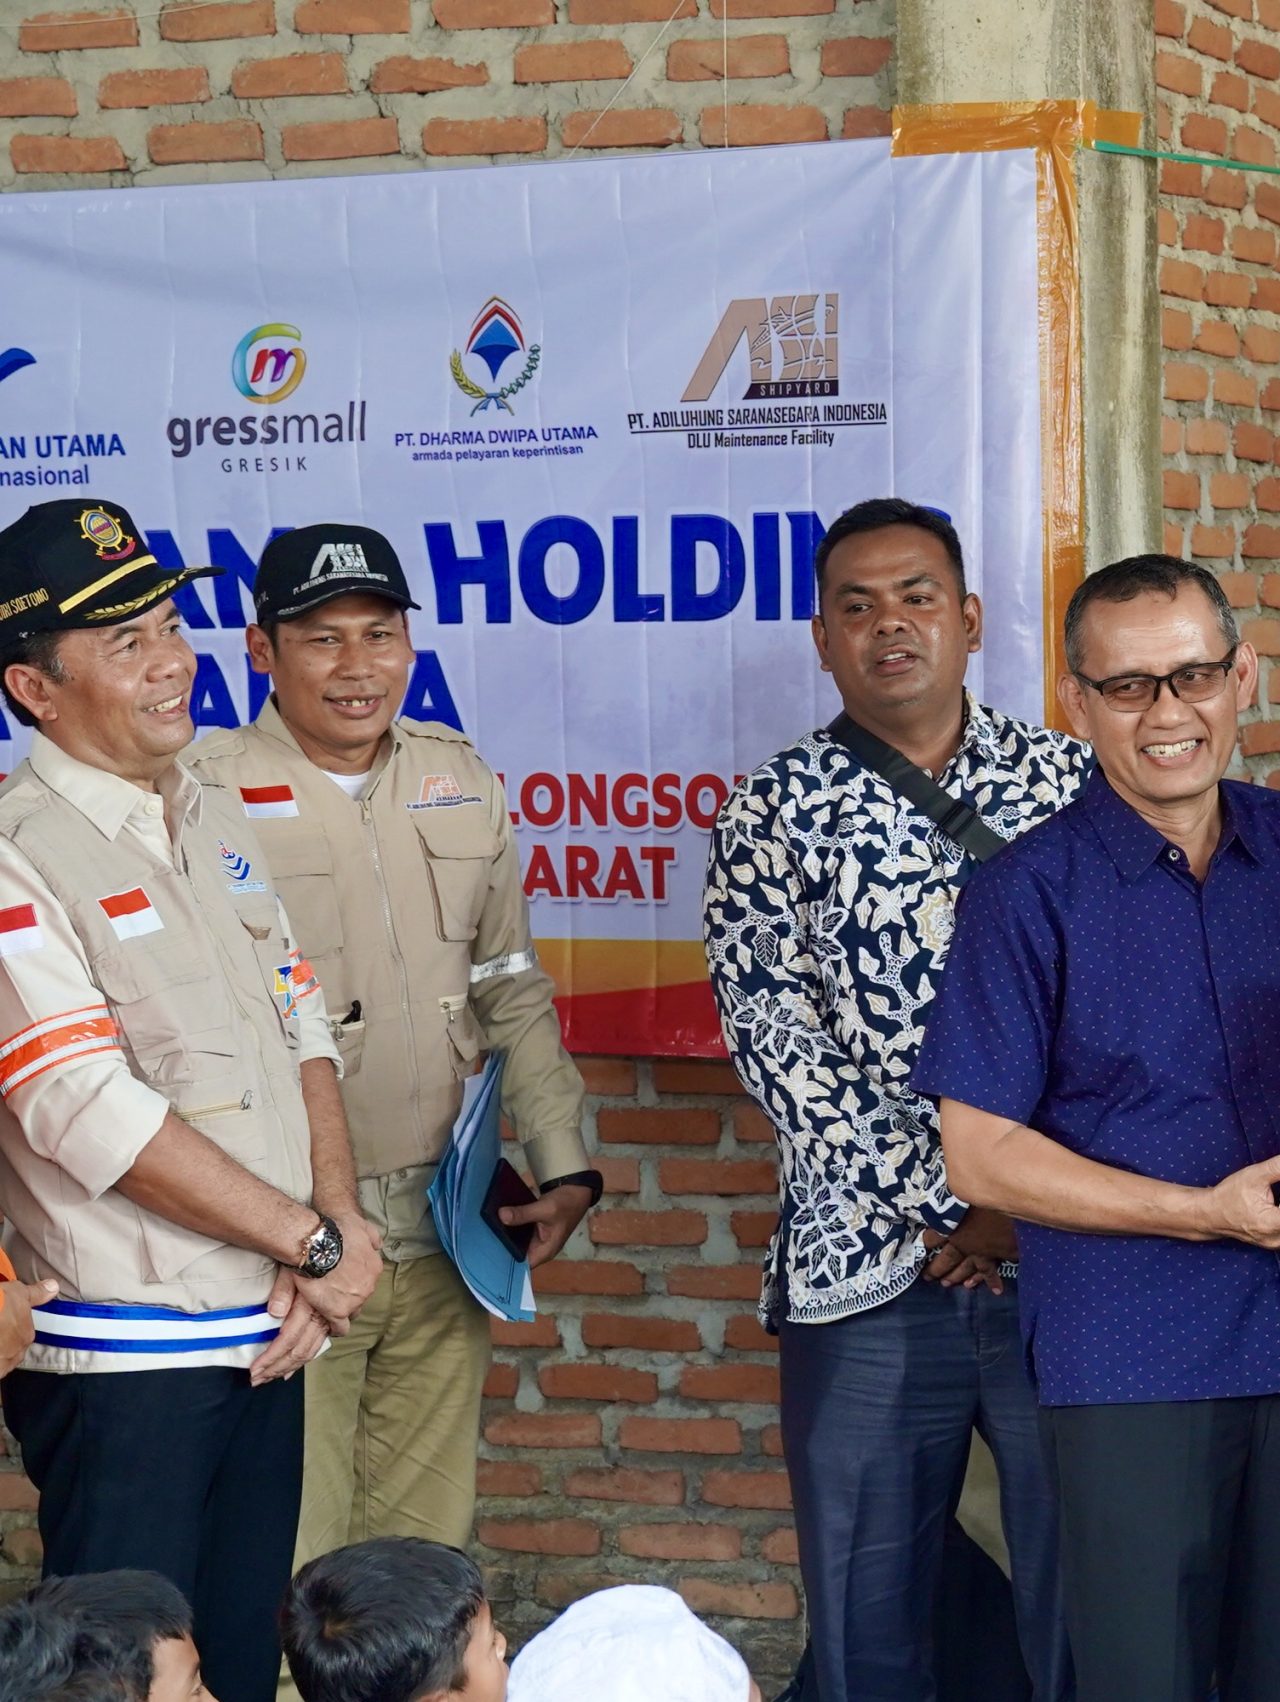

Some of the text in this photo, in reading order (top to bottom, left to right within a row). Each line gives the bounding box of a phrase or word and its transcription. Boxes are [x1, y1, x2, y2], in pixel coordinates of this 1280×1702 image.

[627, 403, 887, 429] PT. ADILUHUNG SARANASEGARA INDONESIA
[167, 400, 366, 458] gressmall
[395, 426, 598, 446] PT. DHARMA DWIPA UTAMA
[687, 429, 835, 448] DLU Maintenance Facility
[35, 433, 127, 458] UTAMA
[412, 445, 583, 462] armada pelayaran keperintisan
[221, 457, 307, 473] GRESIK
[523, 845, 675, 900] ARAT
